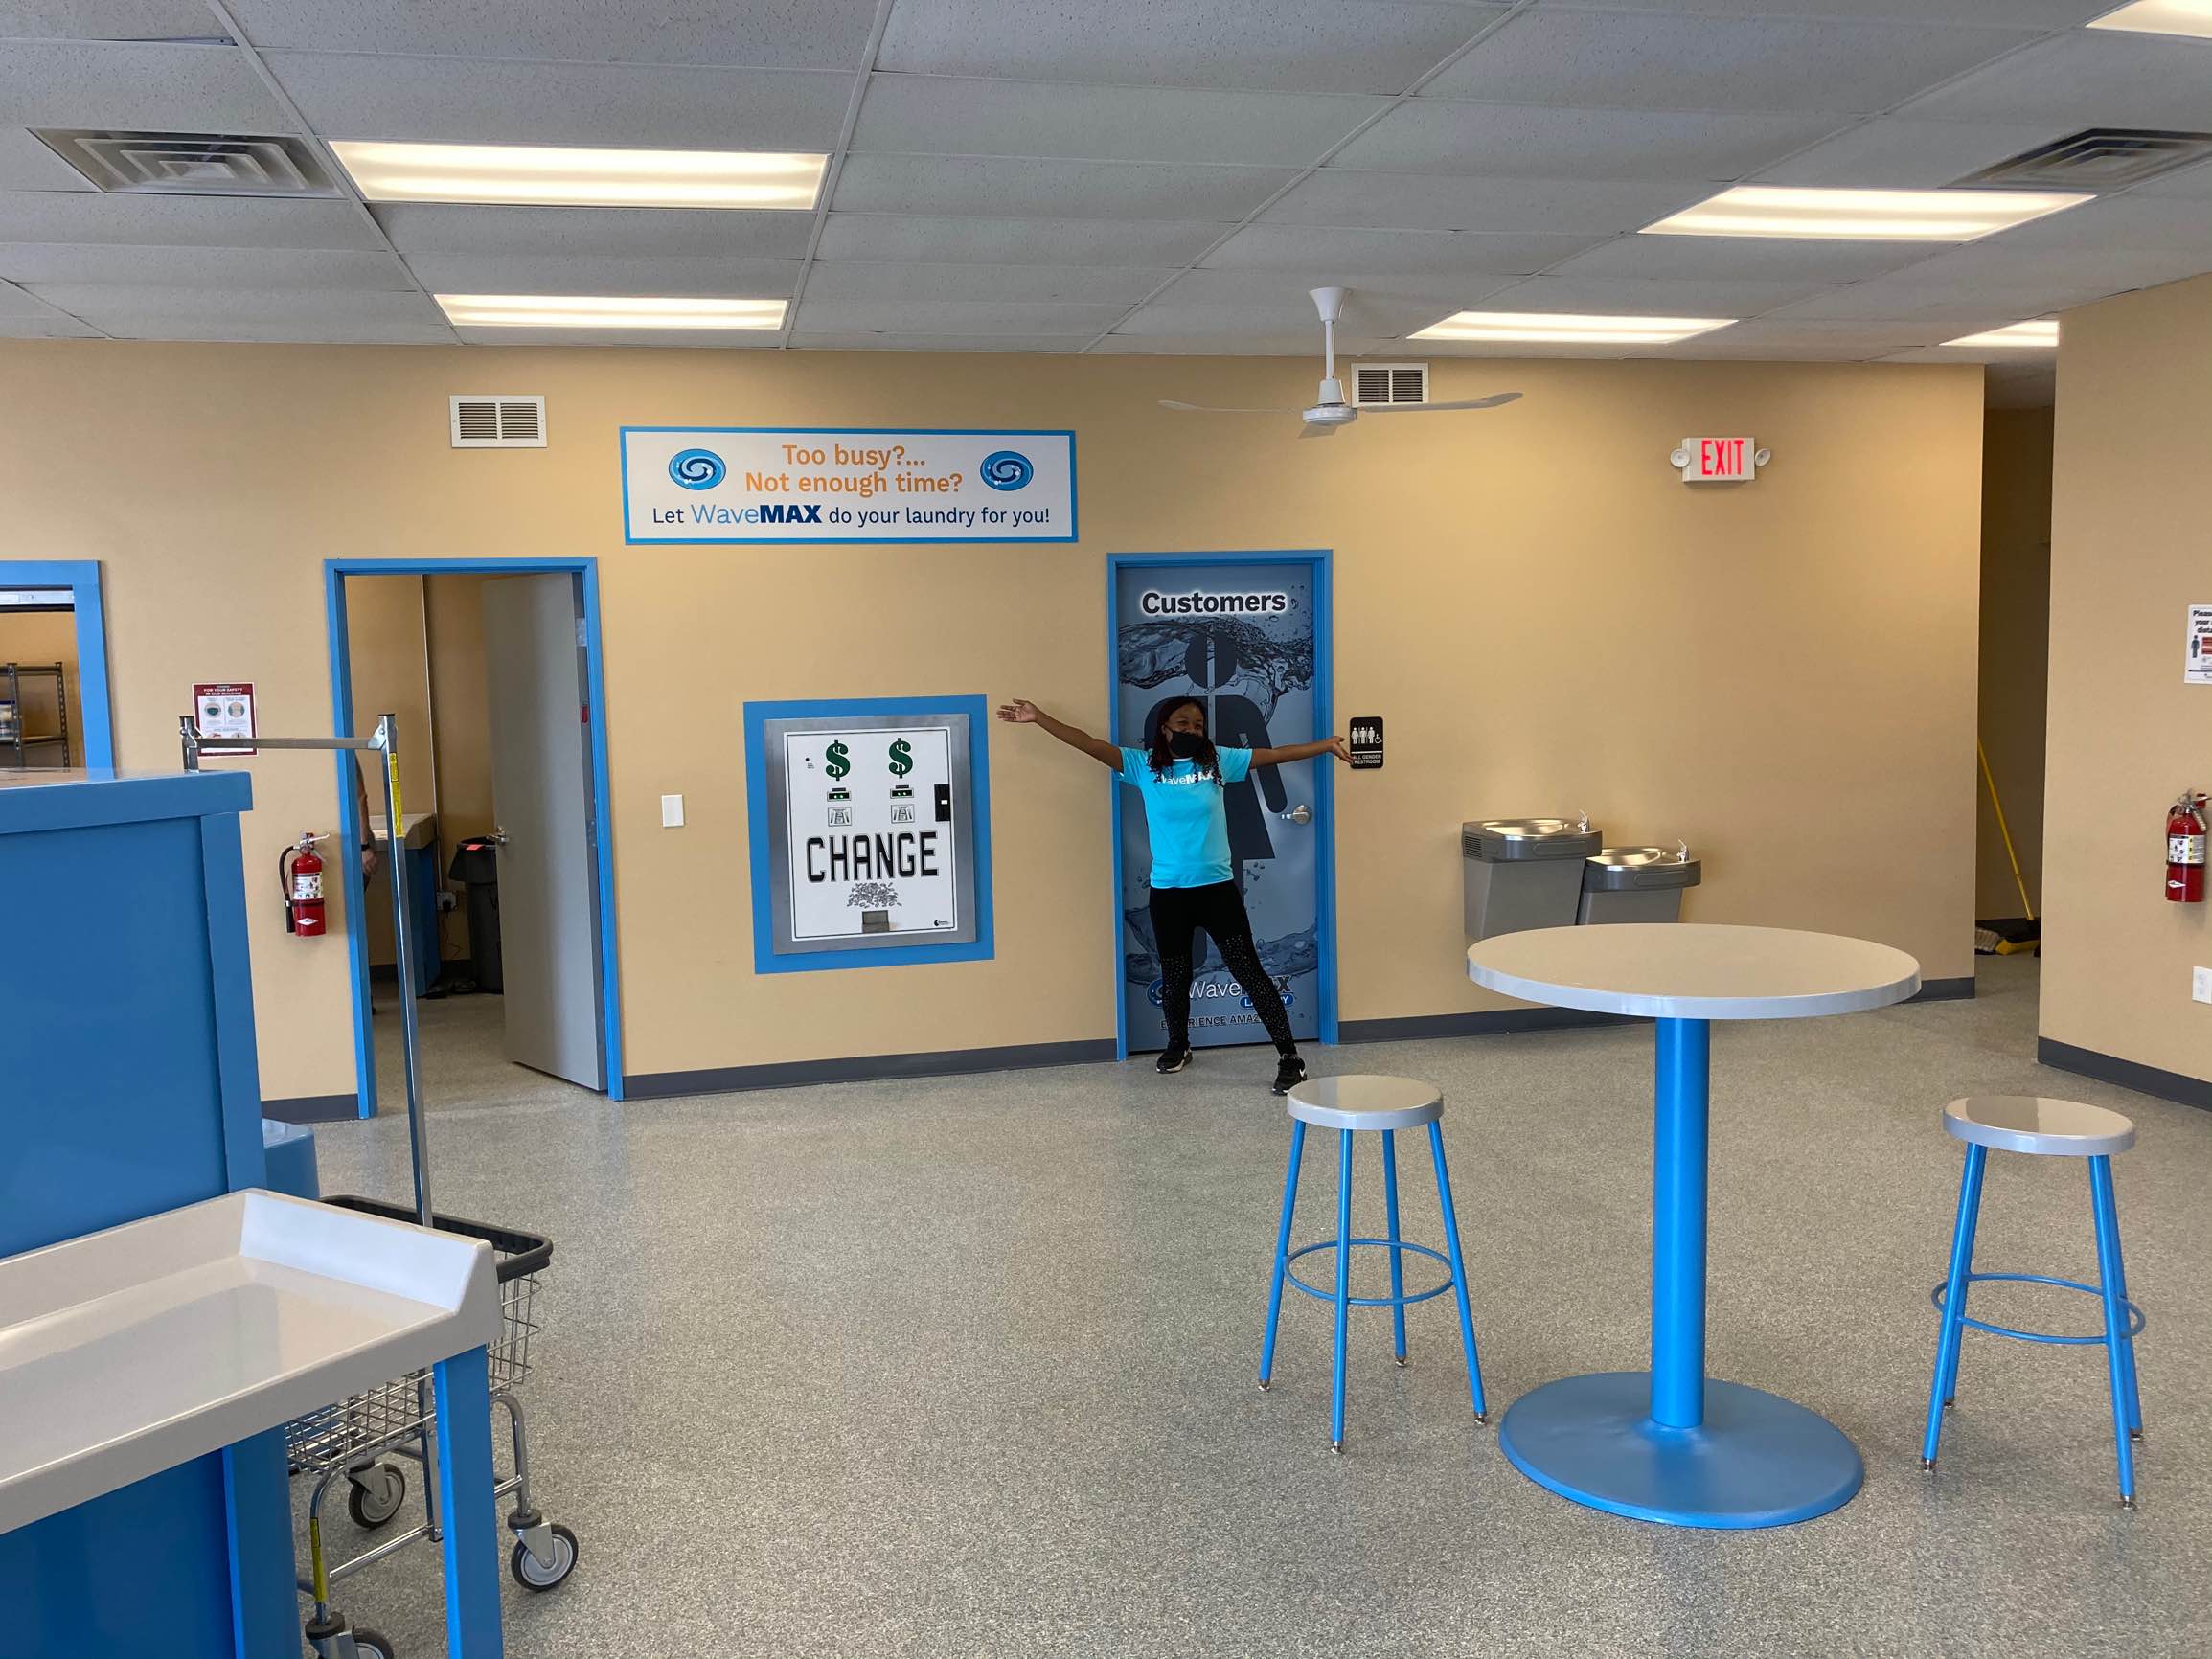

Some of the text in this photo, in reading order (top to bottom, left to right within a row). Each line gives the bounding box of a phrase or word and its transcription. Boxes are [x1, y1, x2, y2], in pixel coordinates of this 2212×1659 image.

[782, 444, 926, 470] Too busy?...
[1701, 440, 1745, 476] EXIT
[745, 472, 964, 498] Not enough time?
[652, 504, 1051, 529] Let WaveMAX do your laundry for you!
[1142, 592, 1287, 614] Customers
[825, 739, 851, 781] $
[888, 737, 913, 779] $
[806, 830, 939, 883] CHANGE
[1190, 975, 1292, 999] WaveX
[1161, 1013, 1262, 1029] ERIENCE AMAZ
